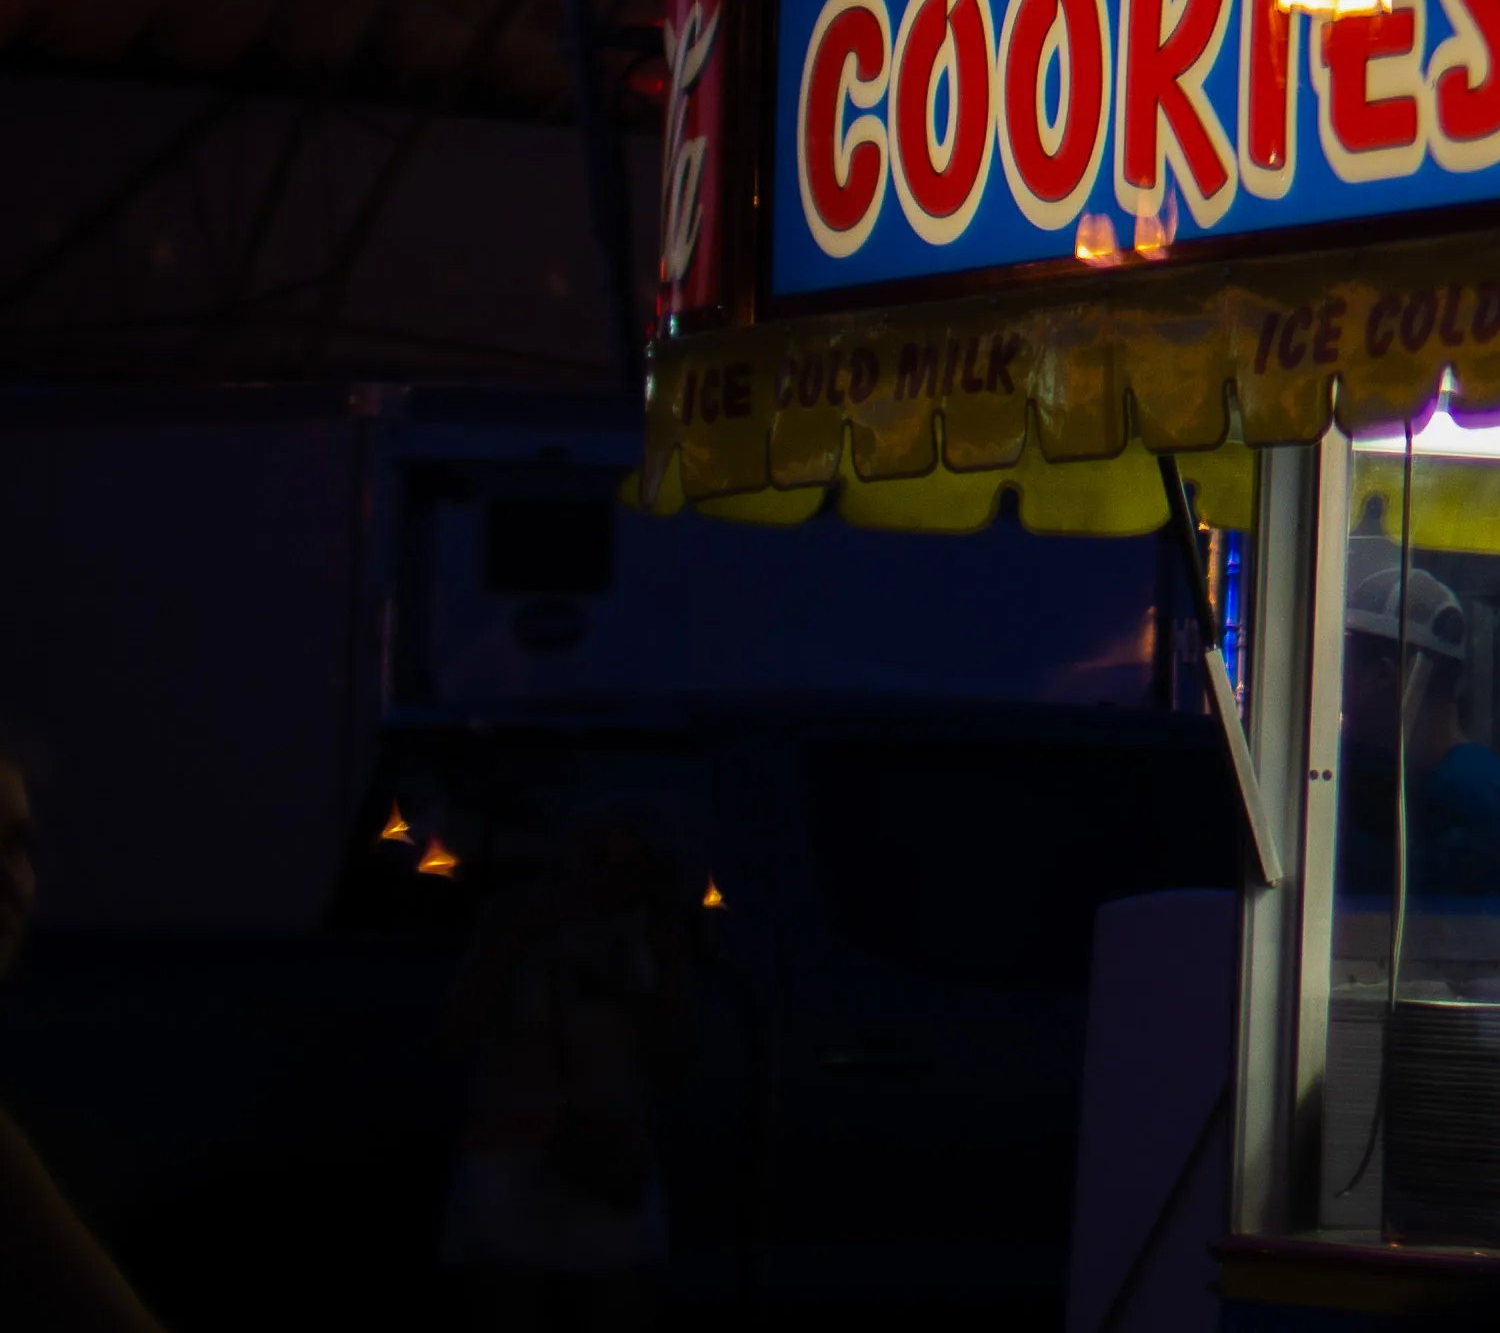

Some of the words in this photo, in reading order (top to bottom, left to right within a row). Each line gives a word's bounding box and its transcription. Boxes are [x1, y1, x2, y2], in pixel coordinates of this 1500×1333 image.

[1254, 299, 1347, 375] ICE
[682, 362, 754, 427] ICE
[774, 346, 880, 410] COLD
[894, 334, 1022, 401] MILK
